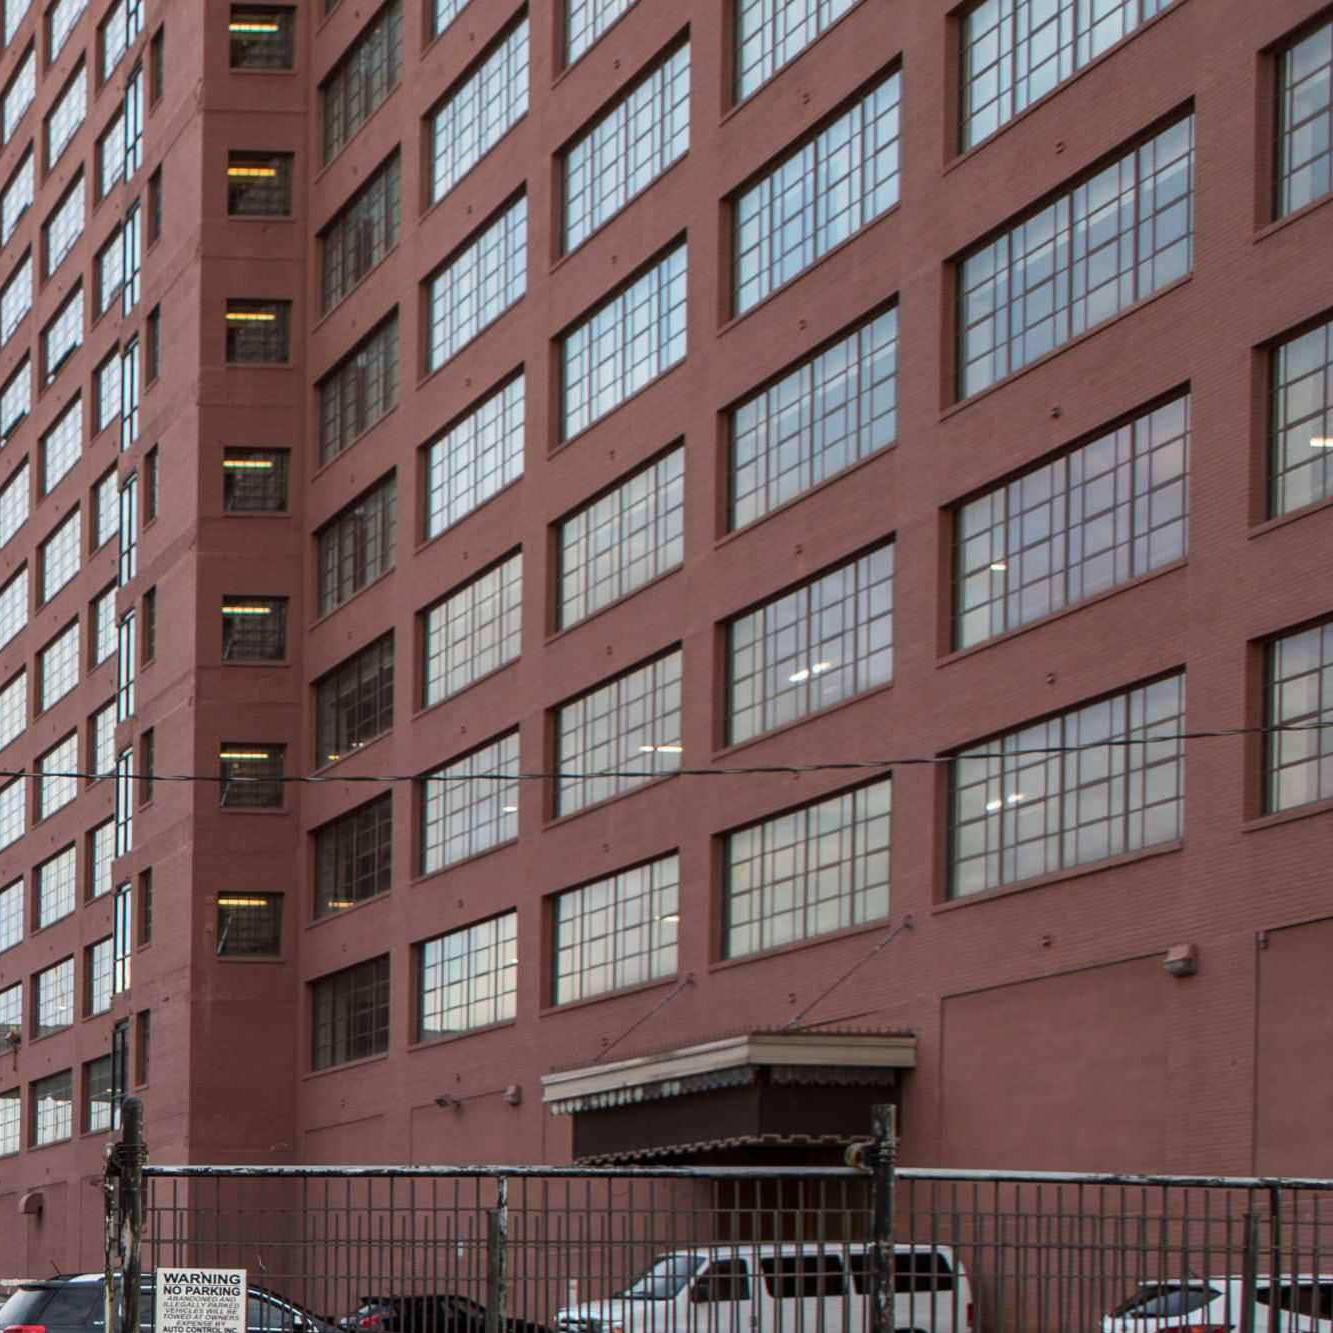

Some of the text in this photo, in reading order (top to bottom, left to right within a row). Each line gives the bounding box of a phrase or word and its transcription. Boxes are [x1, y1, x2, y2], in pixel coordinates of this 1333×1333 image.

[163, 1273, 241, 1285] WARNING
[163, 1286, 241, 1296] NO PARKING
